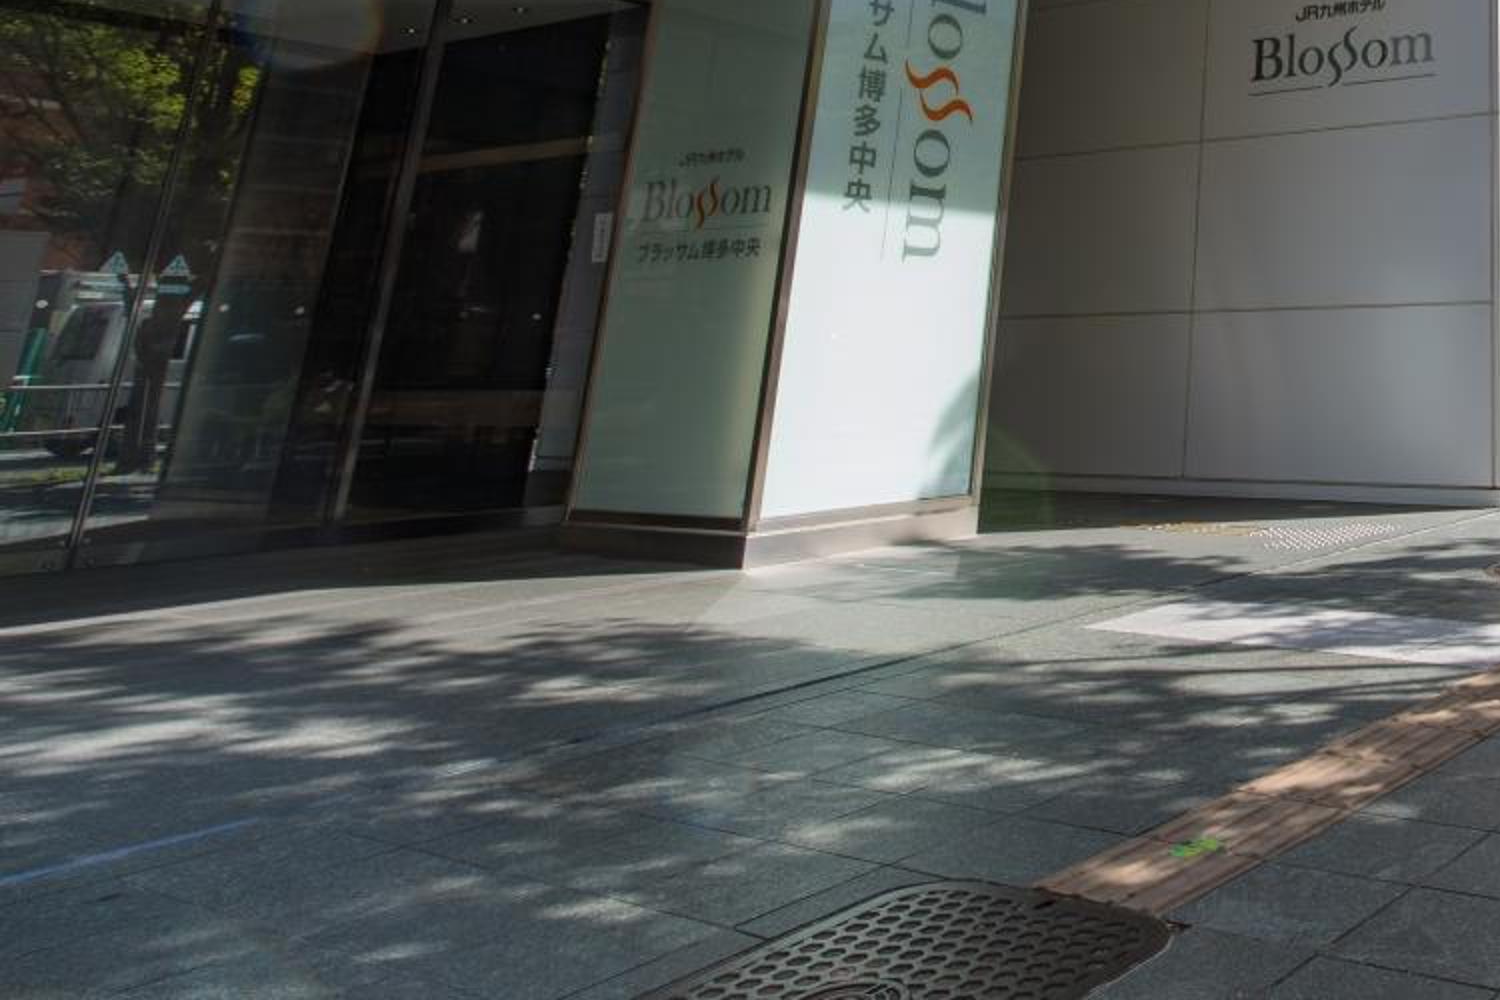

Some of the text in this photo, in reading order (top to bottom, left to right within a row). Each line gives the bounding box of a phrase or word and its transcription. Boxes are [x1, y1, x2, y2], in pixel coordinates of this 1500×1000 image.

[1250, 24, 1436, 88] Blossom
[640, 174, 772, 230] Blossom
[637, 237, 762, 263] ブラッサム博多中央
